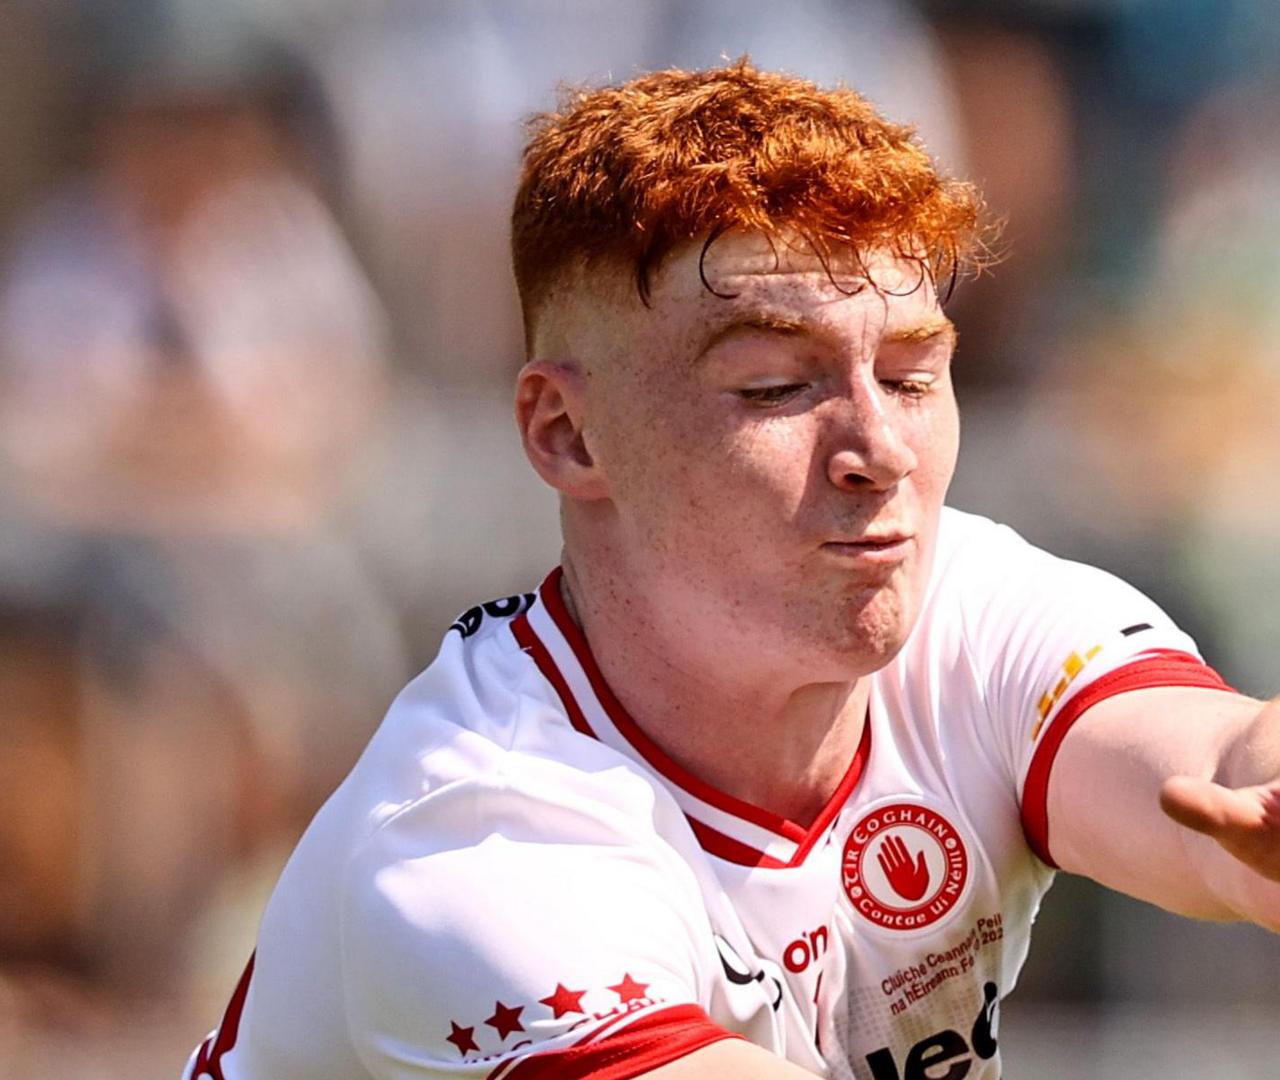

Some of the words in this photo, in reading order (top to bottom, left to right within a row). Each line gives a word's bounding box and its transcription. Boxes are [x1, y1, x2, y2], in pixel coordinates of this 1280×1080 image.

[852, 809, 948, 844] EOGHAIN
[859, 898, 927, 925] Contae
[881, 962, 928, 995] Cluiche
[890, 998, 907, 1016] na
